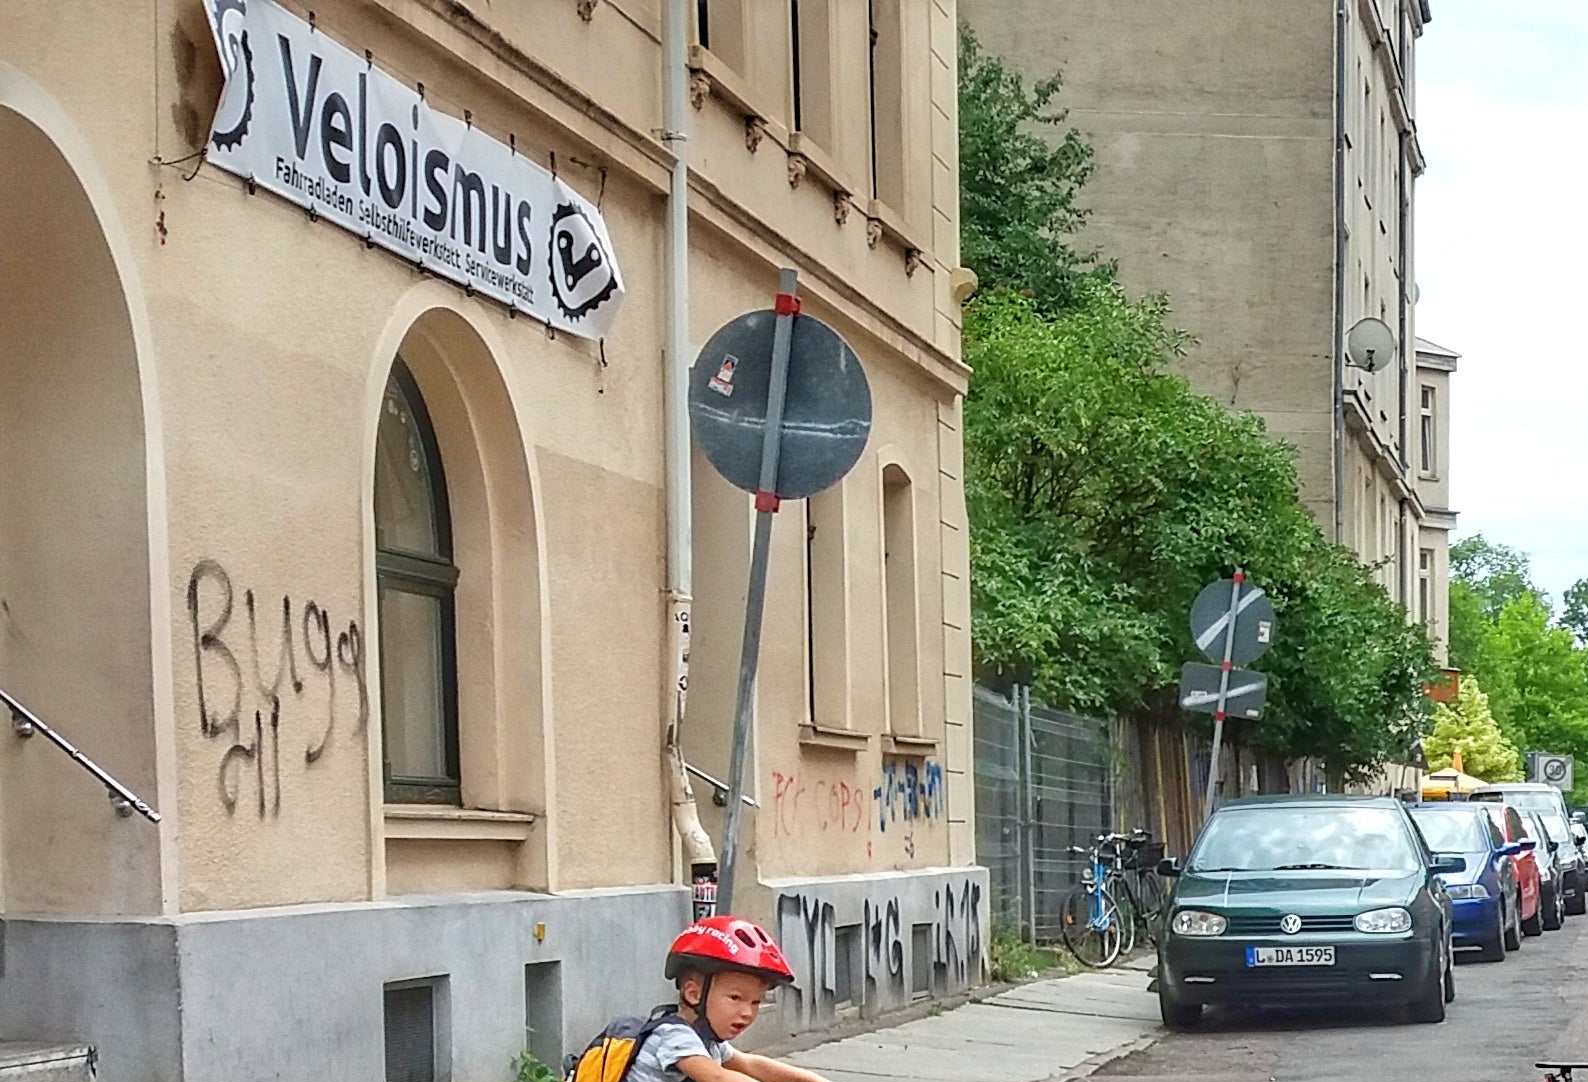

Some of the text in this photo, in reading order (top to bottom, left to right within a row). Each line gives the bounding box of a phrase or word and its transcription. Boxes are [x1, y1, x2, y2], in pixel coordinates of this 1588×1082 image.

[277, 33, 532, 276] Veloismus
[275, 156, 535, 305] Fahrradladen Selbsthilfewerkstatt Servicewerkstatt
[1548, 764, 1563, 776] 30
[705, 926, 740, 955] racing
[1255, 948, 1333, 963] L DA 1595
